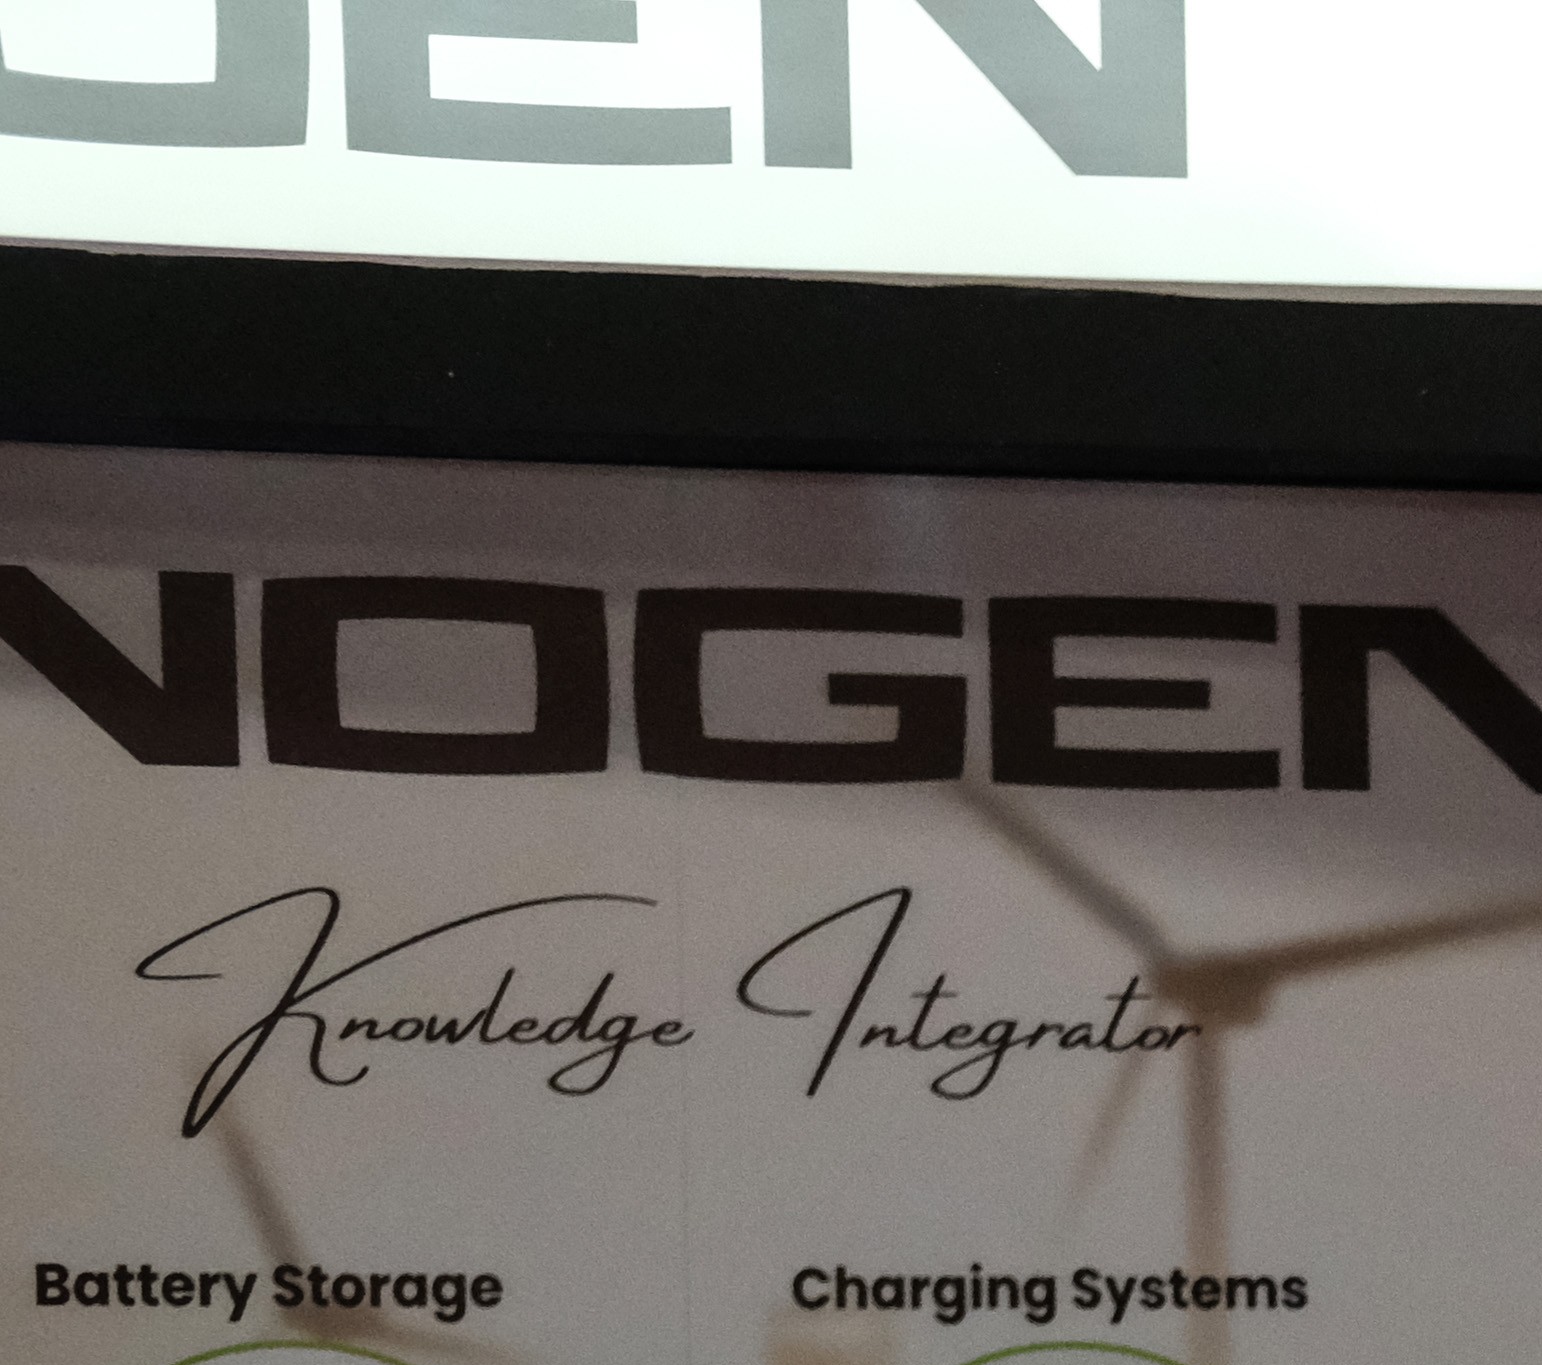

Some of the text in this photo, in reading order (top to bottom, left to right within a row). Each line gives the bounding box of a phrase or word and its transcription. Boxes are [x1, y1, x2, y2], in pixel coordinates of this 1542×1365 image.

[135, 886, 1205, 1140] Knowledge Integrator
[34, 1261, 503, 1324] Battery Storage
[791, 1262, 1308, 1326] Charging Systems
